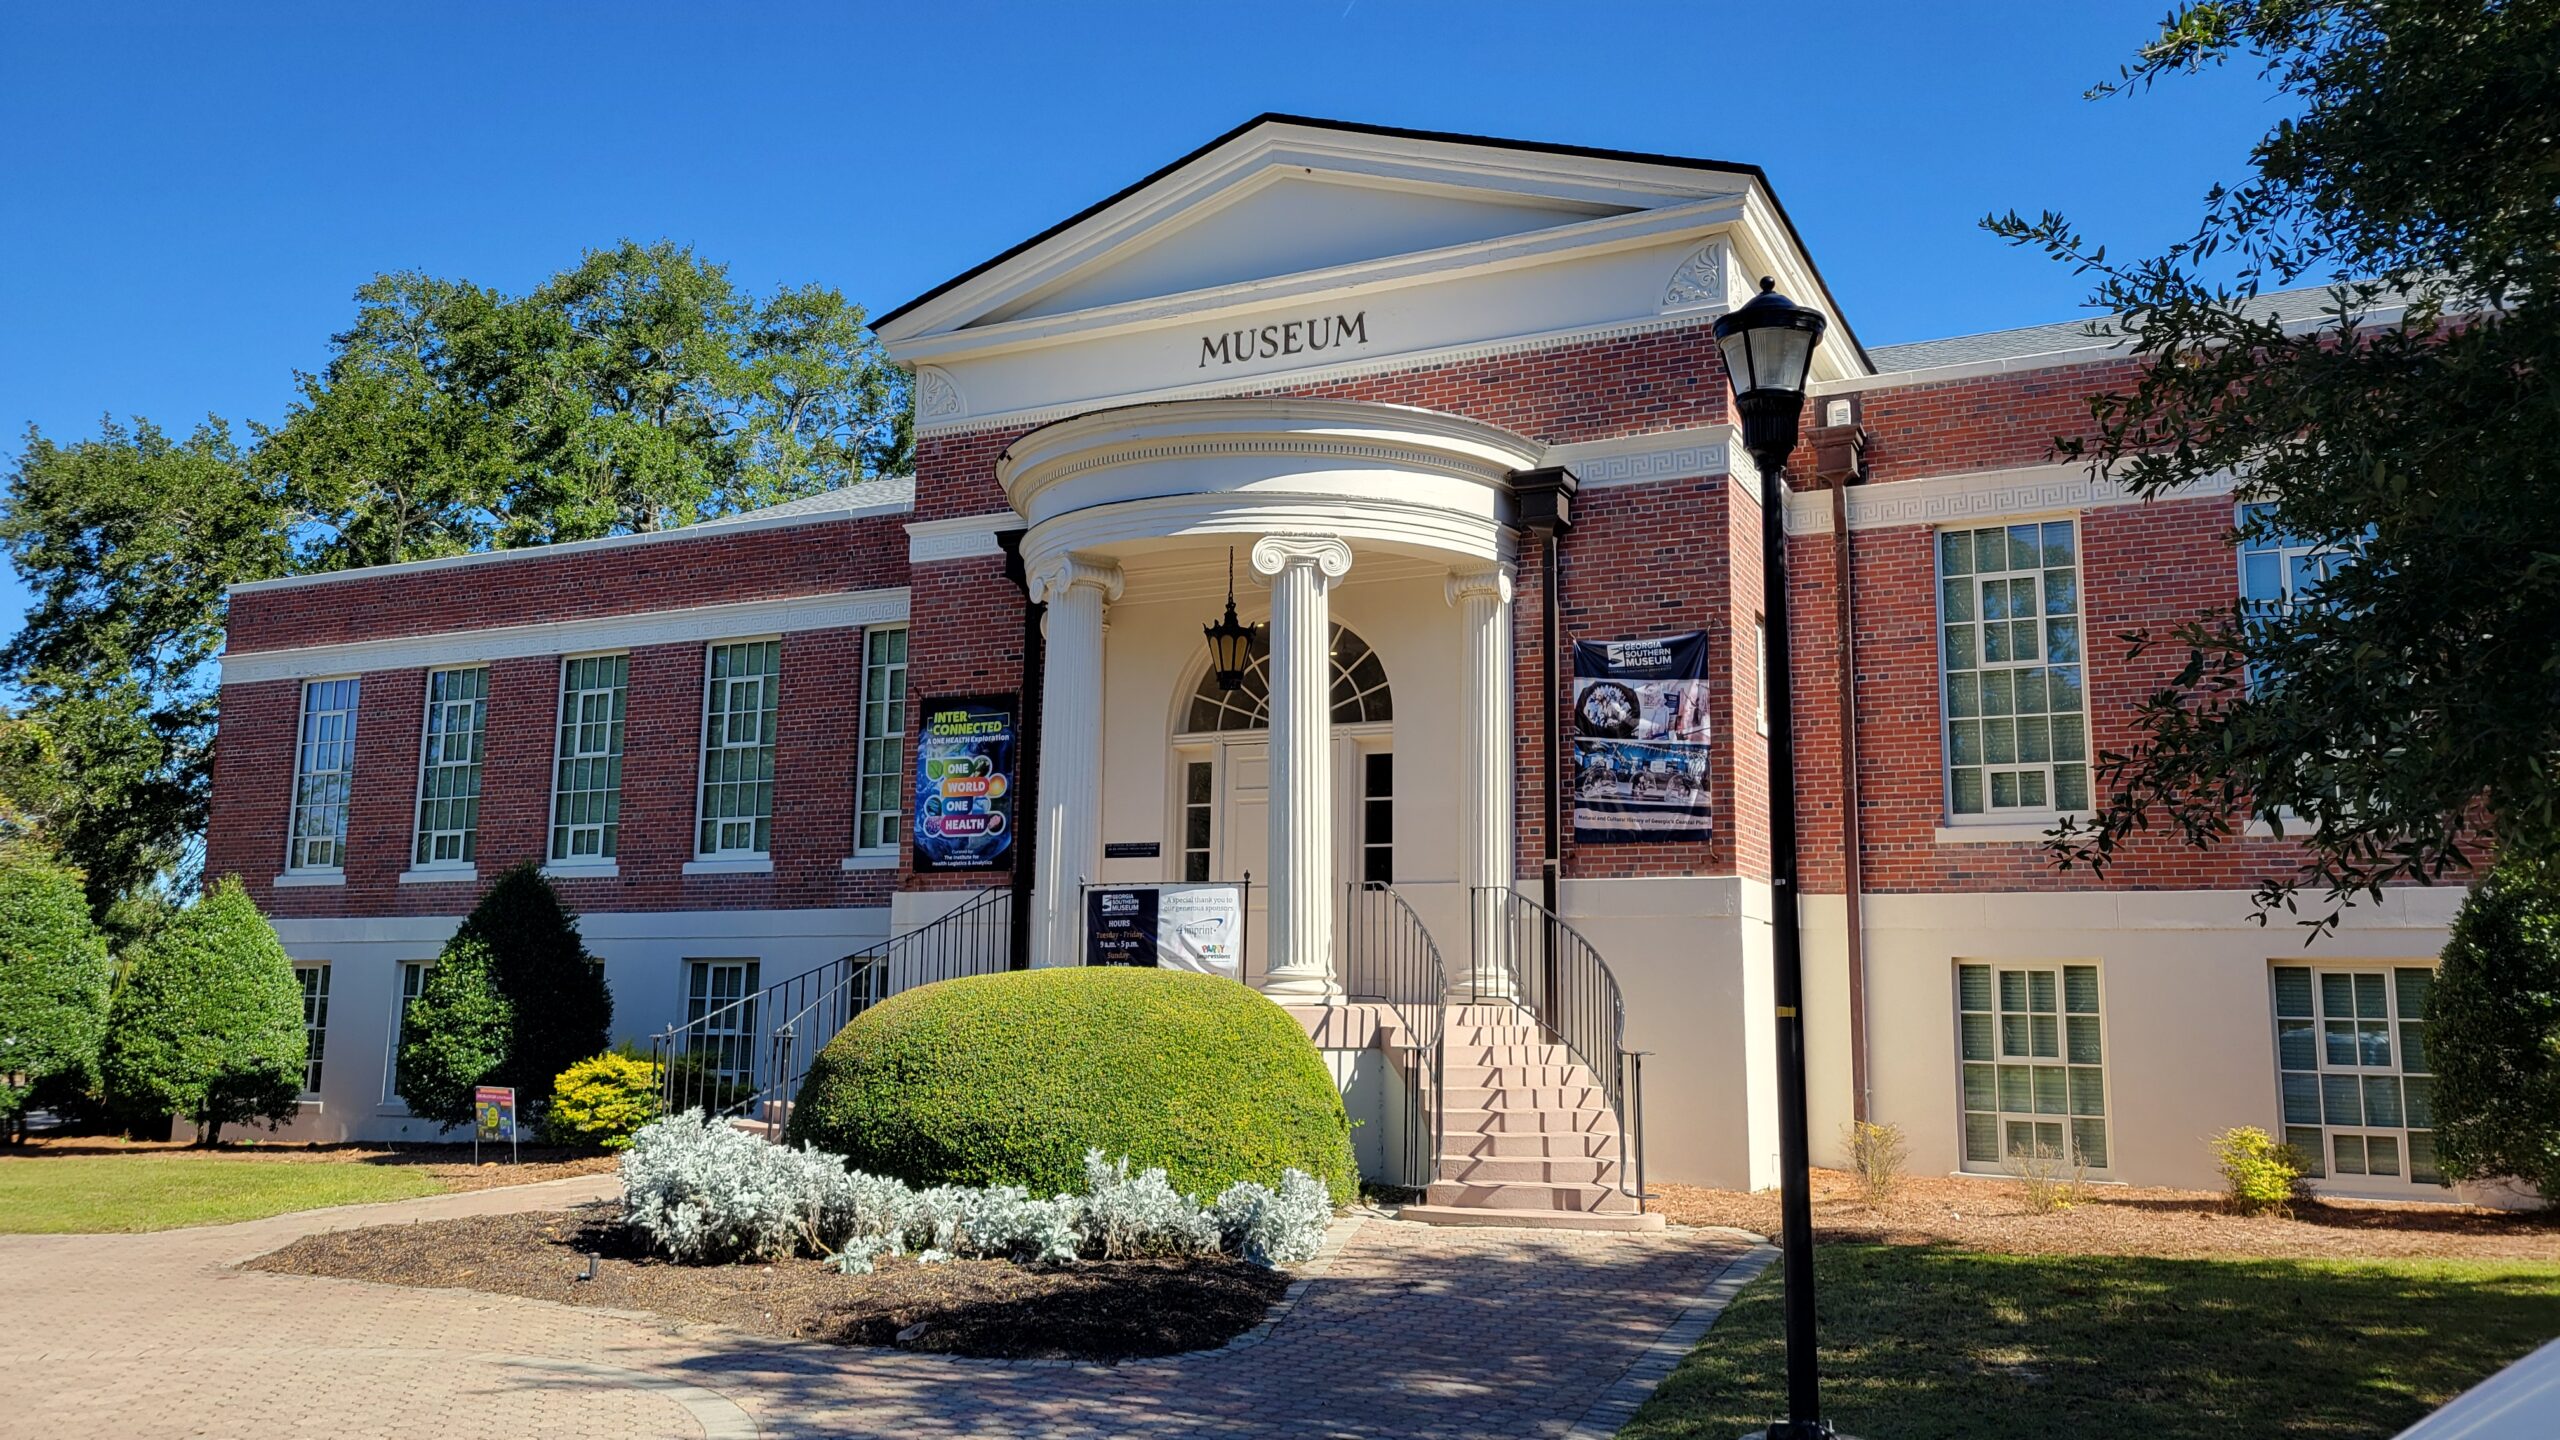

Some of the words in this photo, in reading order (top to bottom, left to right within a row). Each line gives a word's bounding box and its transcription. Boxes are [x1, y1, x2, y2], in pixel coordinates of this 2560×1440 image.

[1199, 311, 1368, 368] MUSEUM
[1624, 641, 1662, 651] GEORGIA
[1625, 648, 1671, 658] SOUTHERN
[1625, 656, 1672, 667] MUSEUM
[933, 711, 967, 723] INTER
[933, 721, 1002, 735] CONNECTED
[932, 737, 945, 745] ONE
[945, 736, 970, 744] HEALTH
[970, 734, 1010, 743] Exploration
[947, 763, 969, 774] ONE
[947, 781, 986, 793] WORLD
[946, 800, 968, 811] ONE
[945, 818, 985, 830] HEALTH
[1172, 895, 1194, 905] special
[1194, 896, 1212, 904] thank
[1212, 897, 1226, 905] you
[1108, 920, 1130, 928] HOURS
[1096, 931, 1119, 939] Tuesday
[1121, 940, 1125, 948] 5
[1201, 944, 1225, 954] PARTY
